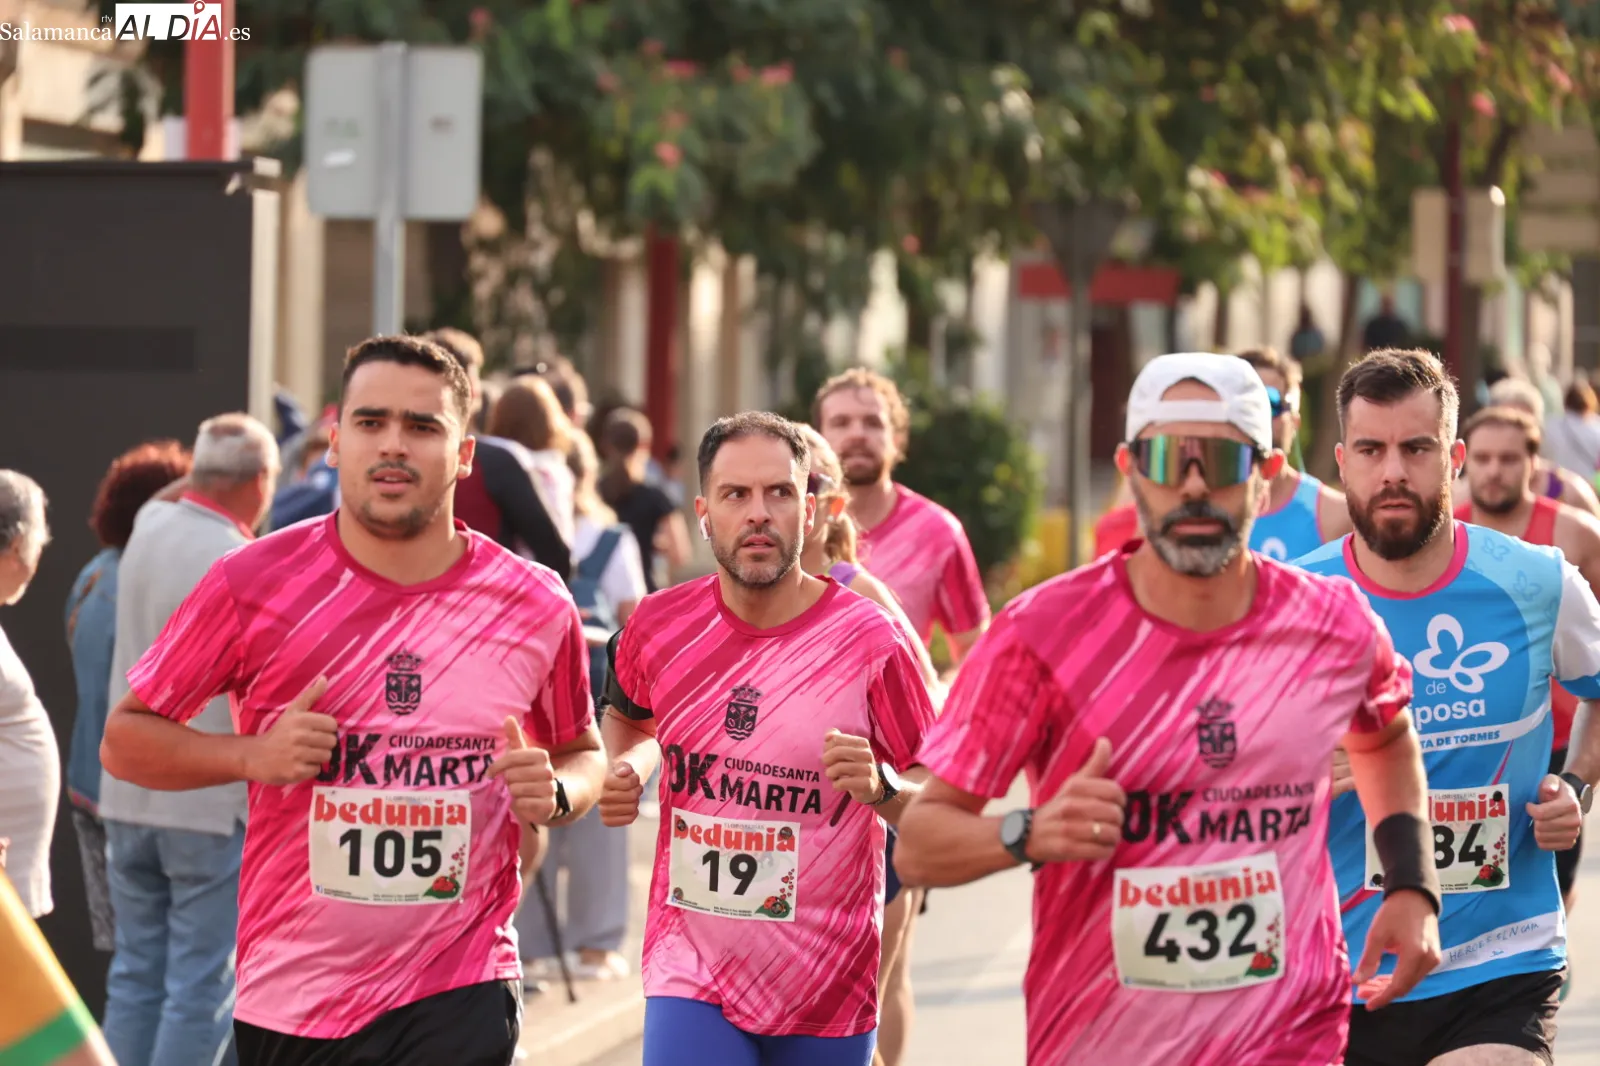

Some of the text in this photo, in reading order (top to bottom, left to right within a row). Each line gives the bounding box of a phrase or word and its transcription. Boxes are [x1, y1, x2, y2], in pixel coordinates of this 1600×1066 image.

[1425, 680, 1447, 696] de
[388, 734, 496, 751] CIUDADESANTA
[1436, 736, 1452, 747] DE
[1453, 730, 1501, 744] TORMES
[383, 753, 495, 786] MARTA
[724, 757, 820, 783] CIUDADESANTA
[313, 793, 467, 827] bedunia
[719, 773, 822, 815] MARTA
[673, 814, 796, 852] bedunia
[339, 828, 443, 878] 105
[702, 850, 758, 896] 19
[1119, 867, 1277, 908] bedunia
[1143, 903, 1257, 964] 432
